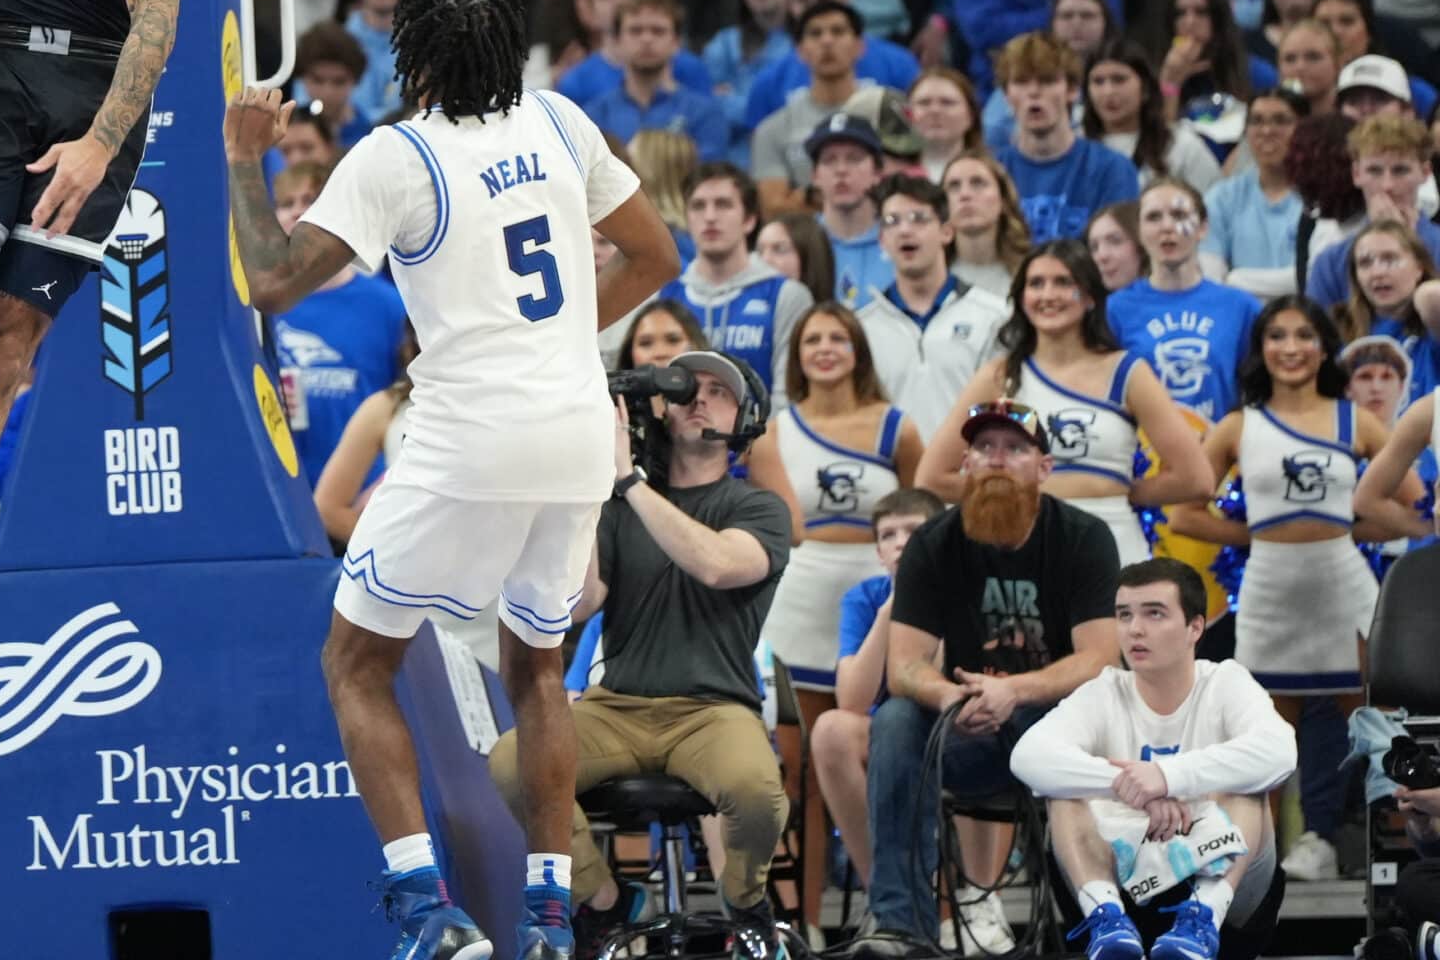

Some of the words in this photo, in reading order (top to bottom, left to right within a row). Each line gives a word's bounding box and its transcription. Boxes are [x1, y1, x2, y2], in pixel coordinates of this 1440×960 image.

[479, 152, 547, 199] NEAL
[503, 214, 565, 322] 5
[1146, 310, 1215, 339] BLUE
[104, 426, 180, 473] BIRD
[106, 471, 183, 516] CLUB
[981, 576, 1041, 617] AIR
[96, 744, 360, 818] Physician
[26, 805, 240, 870] Mutual
